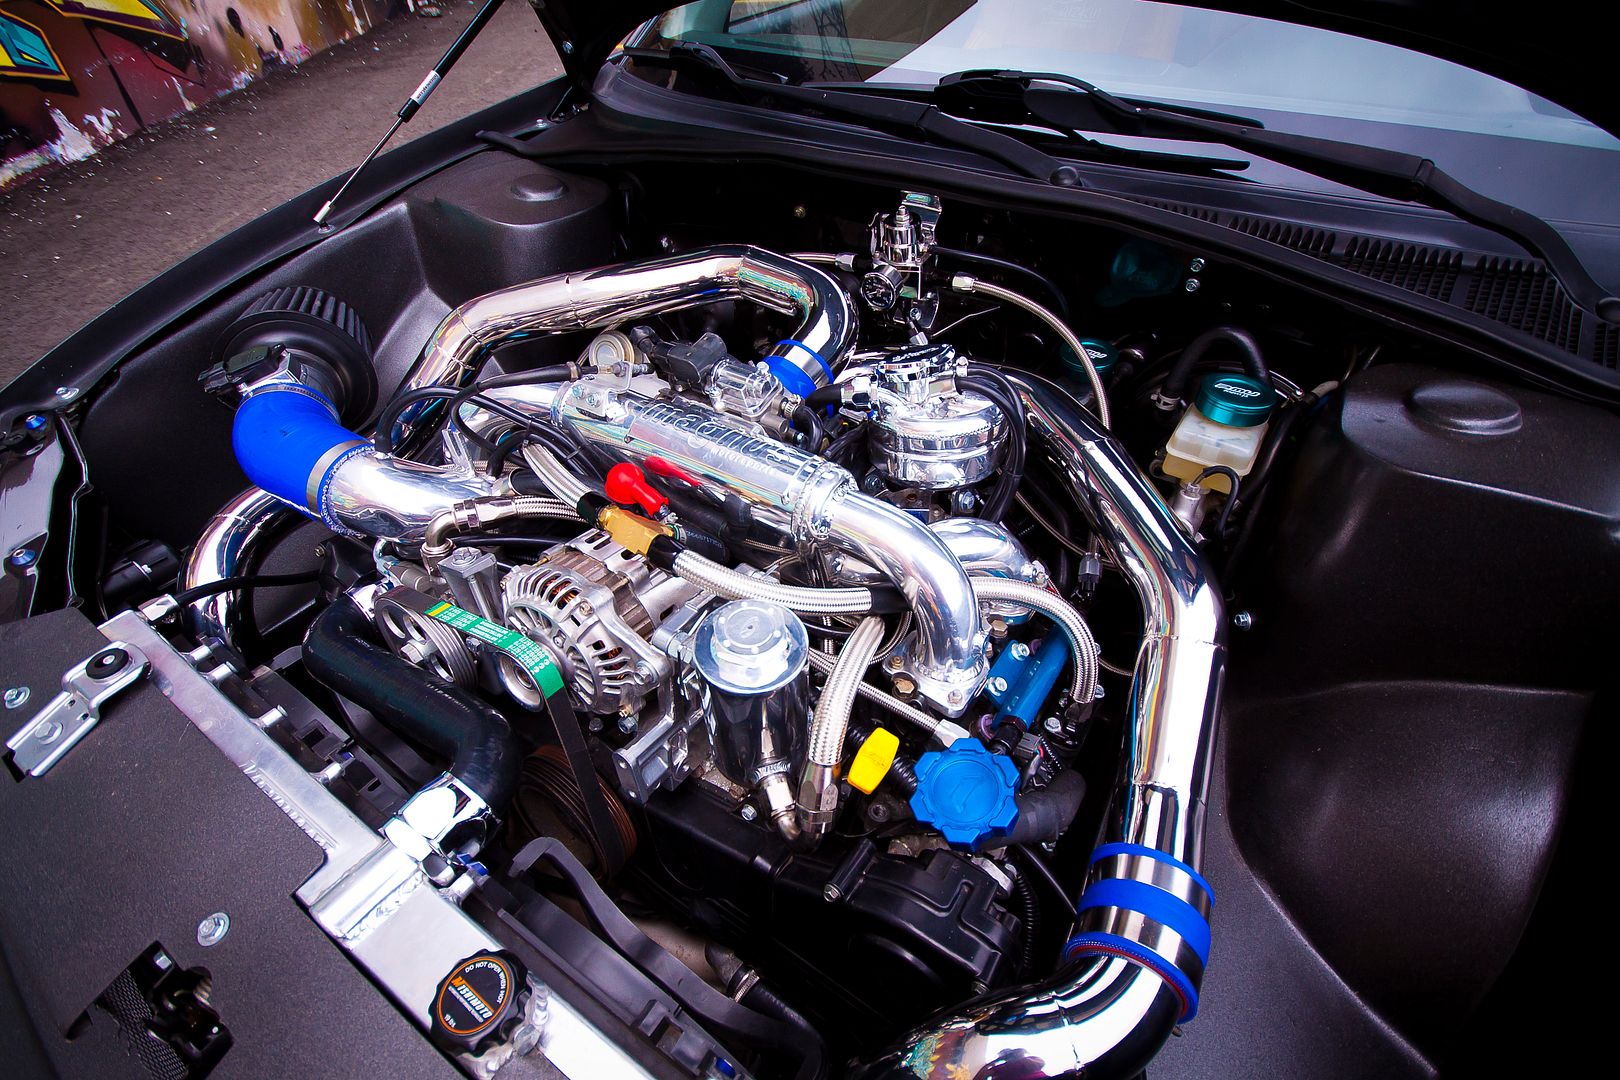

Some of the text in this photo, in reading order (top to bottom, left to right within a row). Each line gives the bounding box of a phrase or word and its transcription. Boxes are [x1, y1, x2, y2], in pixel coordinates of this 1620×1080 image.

[640, 403, 799, 467] magnus
[451, 976, 493, 1018] MISHIMOTO
[465, 961, 506, 1004] DO NOT OPEN WHEN HOT
